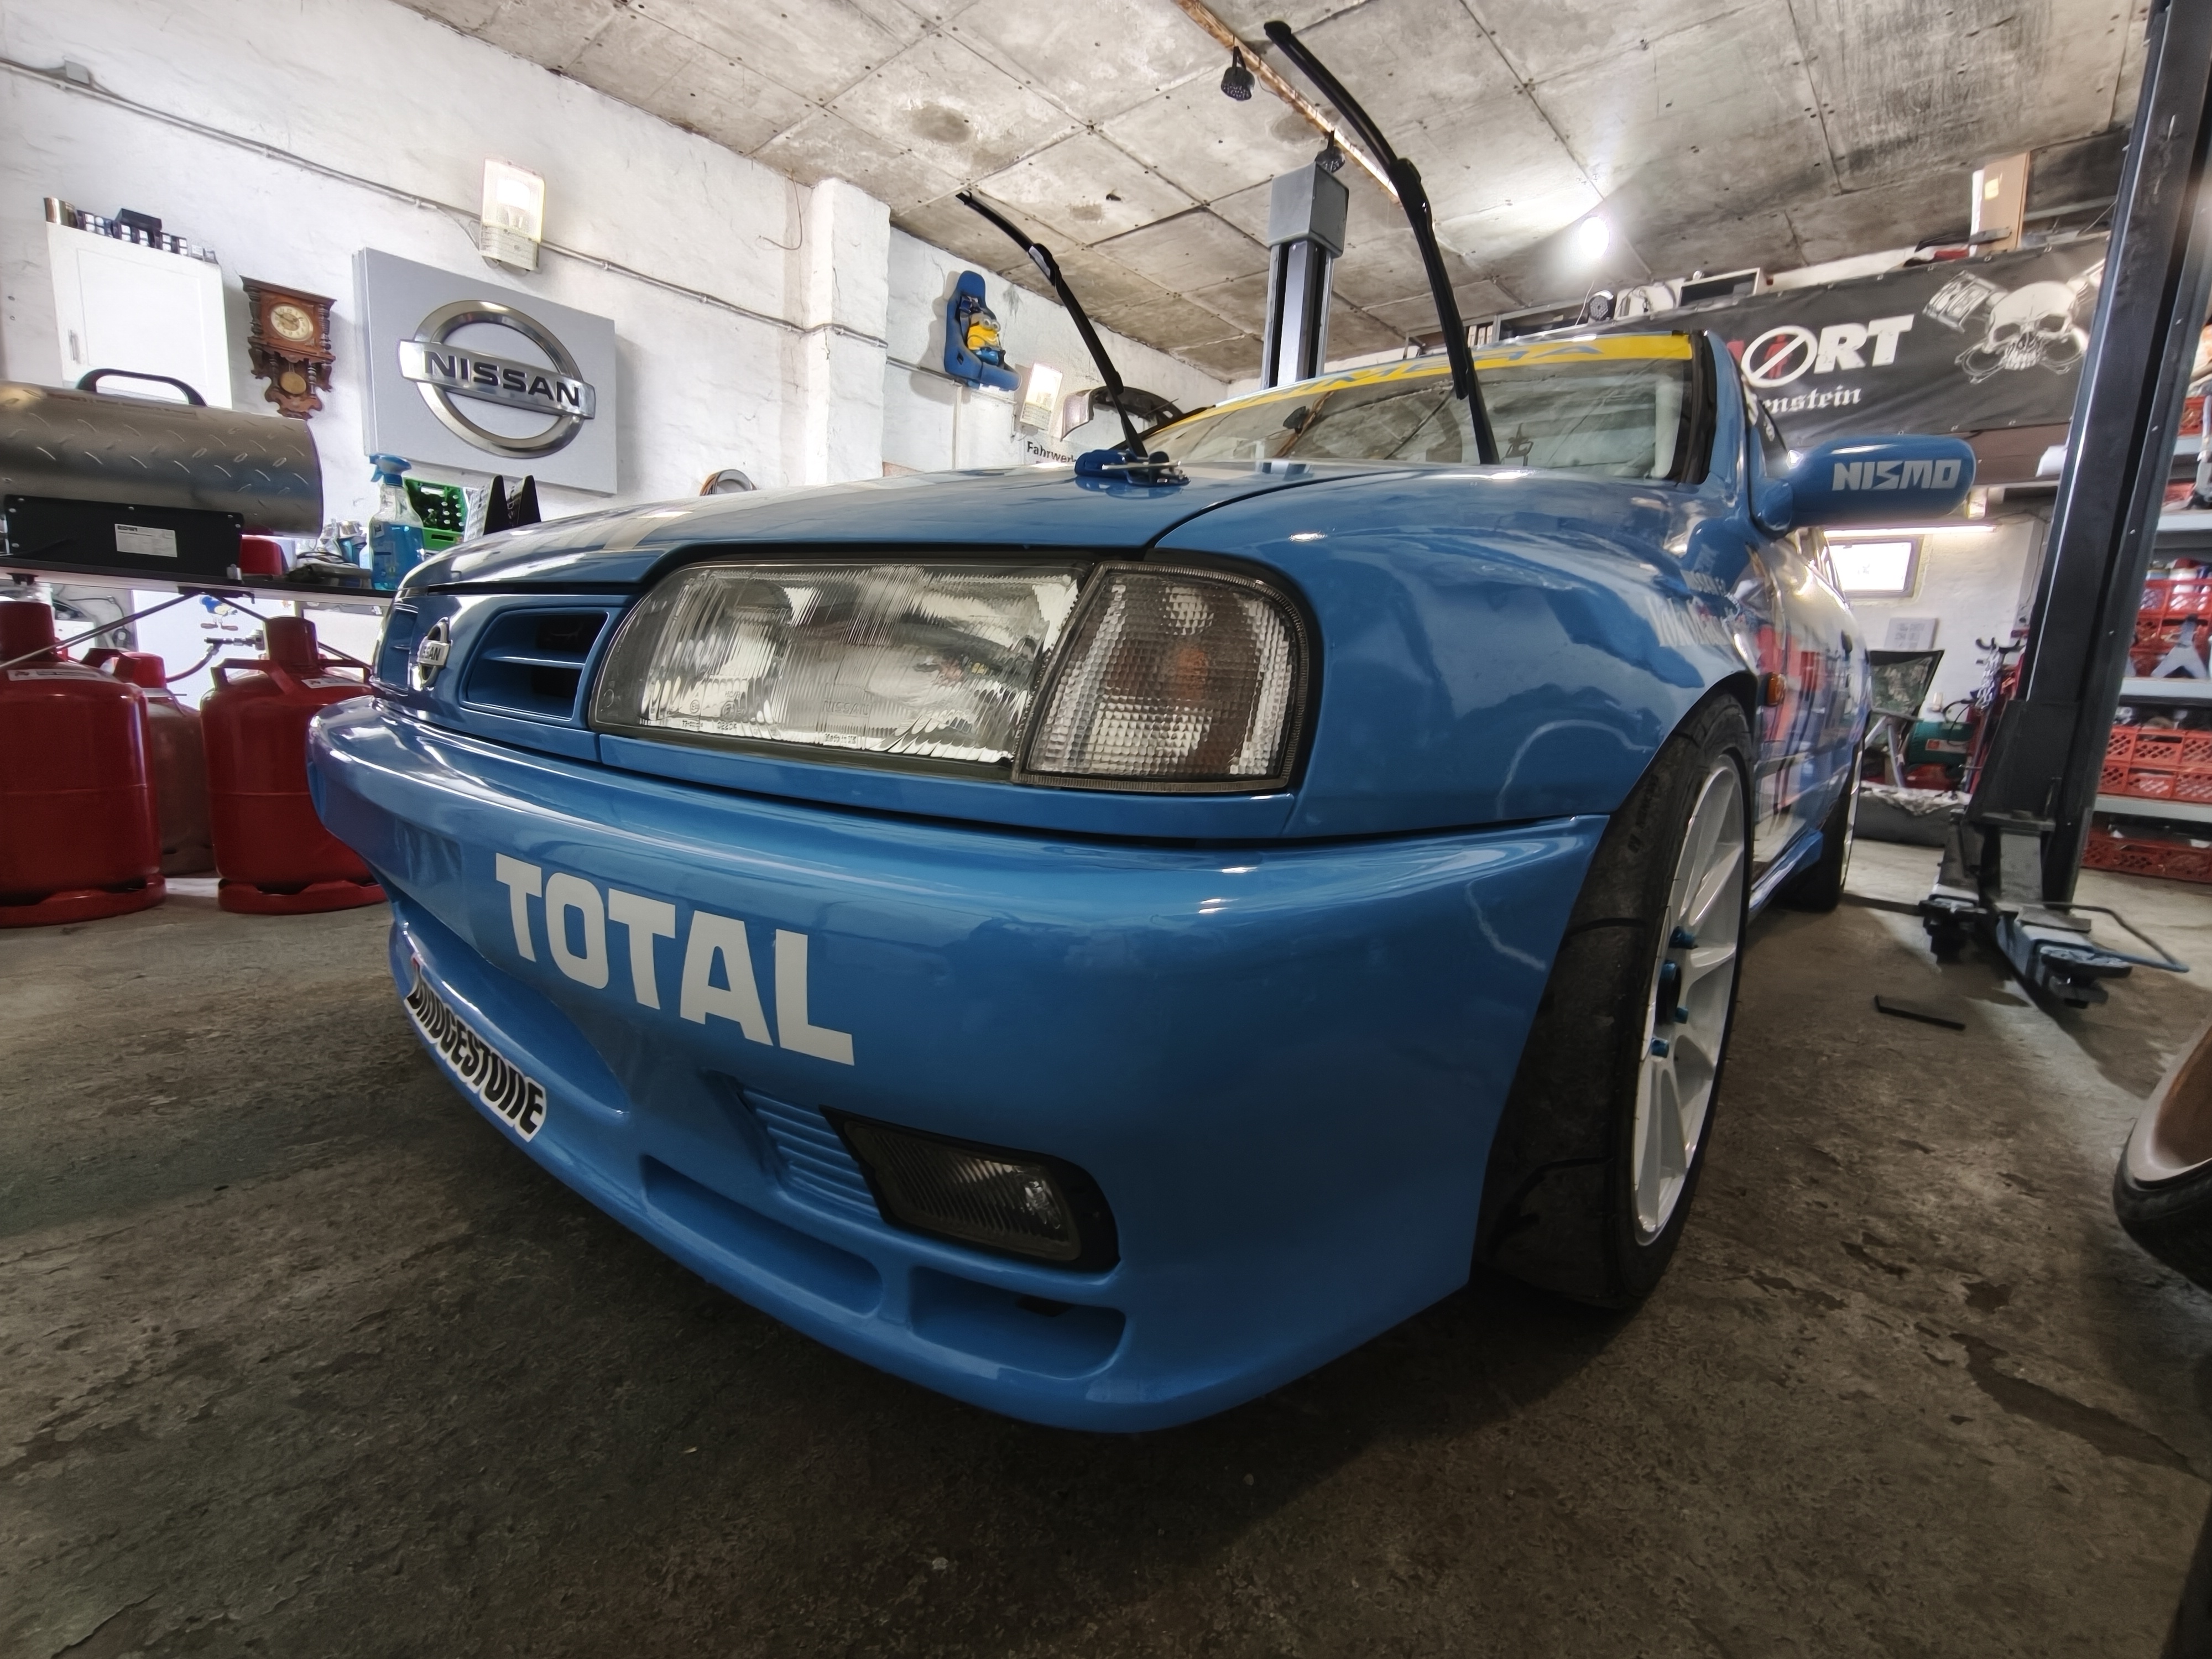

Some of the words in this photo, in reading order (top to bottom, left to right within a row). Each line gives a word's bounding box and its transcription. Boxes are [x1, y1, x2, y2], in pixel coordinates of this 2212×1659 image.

[1726, 314, 1914, 388] ORT
[424, 351, 580, 406] NISSAN
[1762, 385, 1862, 414] nstein
[1832, 460, 1961, 491] NISMO
[822, 700, 869, 715] NISSAN
[495, 852, 855, 1066] TOTAL
